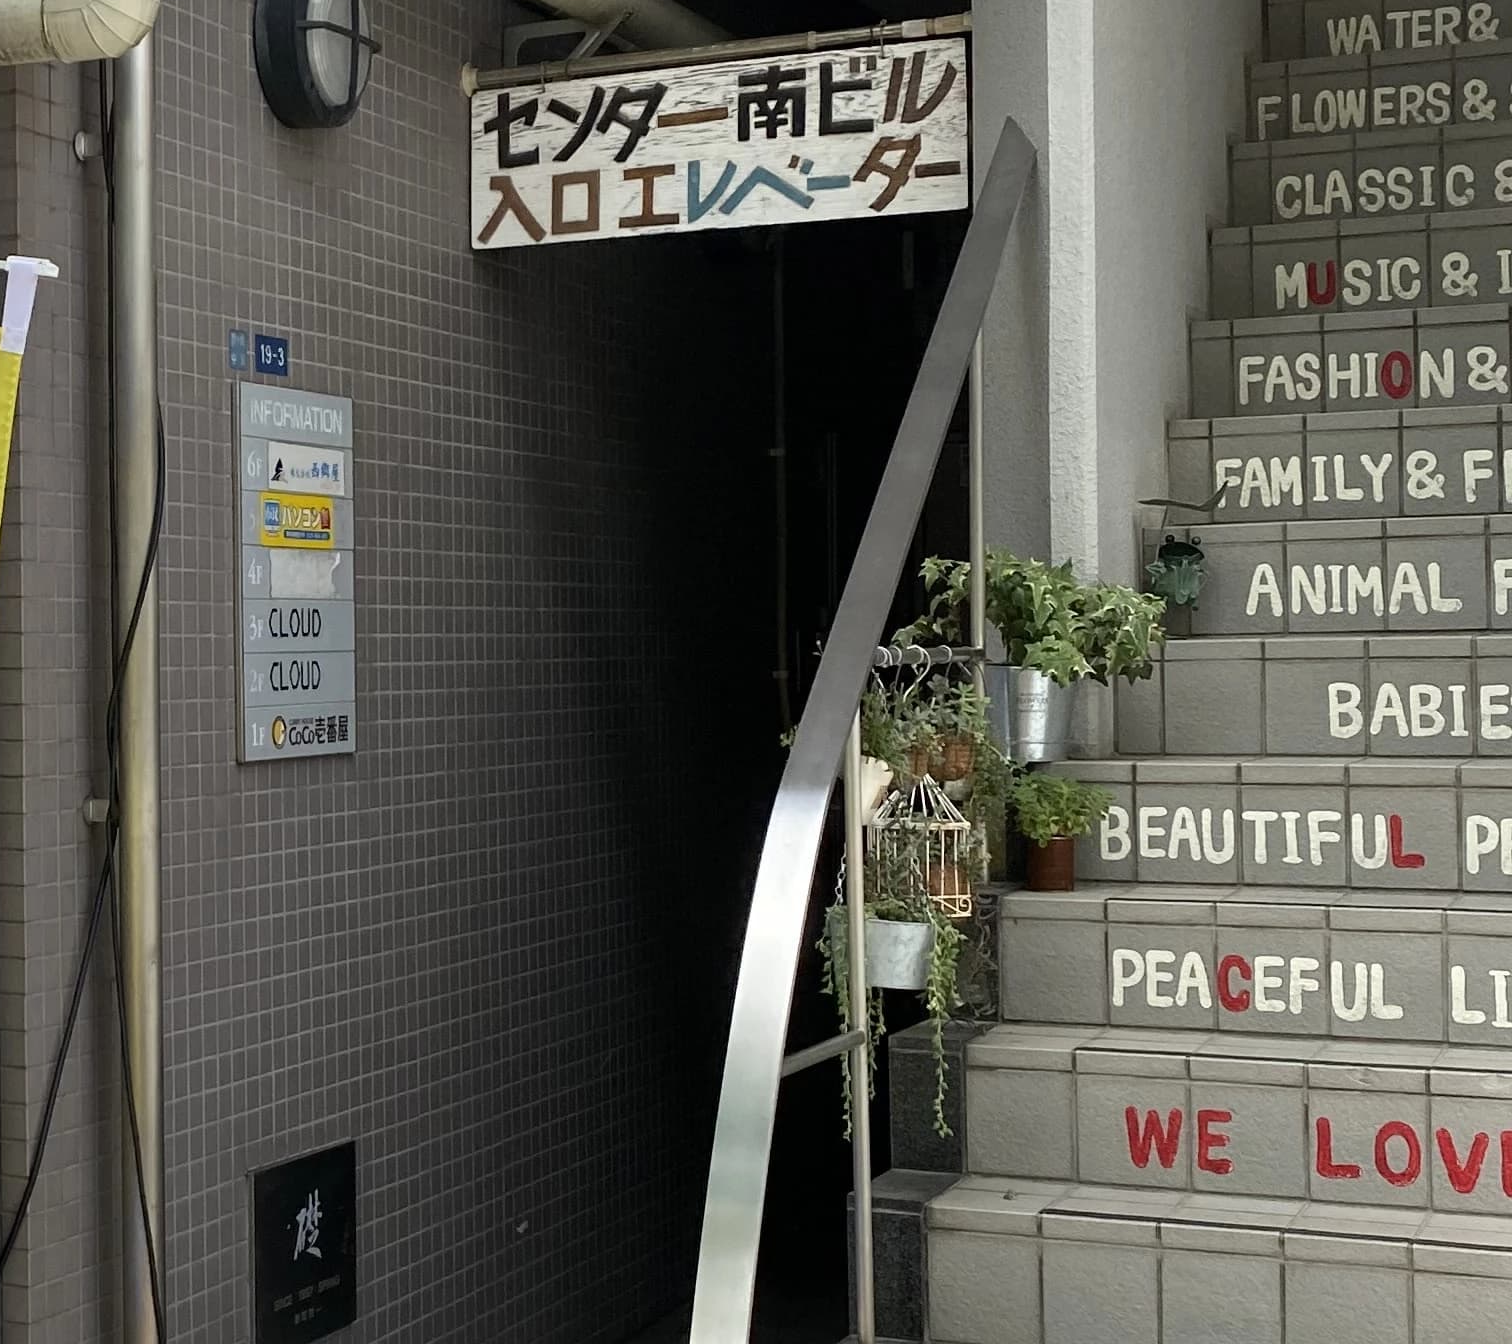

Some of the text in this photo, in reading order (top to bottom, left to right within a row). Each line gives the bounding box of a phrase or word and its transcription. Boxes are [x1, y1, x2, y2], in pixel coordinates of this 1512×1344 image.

[1327, 7, 1461, 56] WATER
[484, 50, 958, 169] センター南ビル
[1257, 78, 1497, 141] FLOWERS &
[478, 134, 961, 243] 入口エレベーター
[1275, 164, 1475, 219] CLASSIC
[1275, 257, 1421, 310] MUSIC
[1442, 251, 1478, 296] &
[260, 343, 285, 367] 19-3
[1239, 345, 1508, 405] FASHION &
[250, 399, 344, 435] INFORMATION
[1215, 453, 1394, 508] FAMILY
[1406, 449, 1446, 500] &
[247, 558, 264, 585] 4F
[1245, 561, 1462, 618] ANIMAL
[248, 614, 264, 641] 3F
[268, 607, 322, 638] CLOUD
[249, 667, 265, 693] 2F
[269, 660, 321, 691] CLOUD
[251, 722, 265, 747] 1F
[1328, 682, 1512, 740] BABIE
[1099, 805, 1426, 869] BEAUTIFUL
[1111, 948, 1404, 1022] PEACEFUL
[1124, 1105, 1233, 1175] WE
